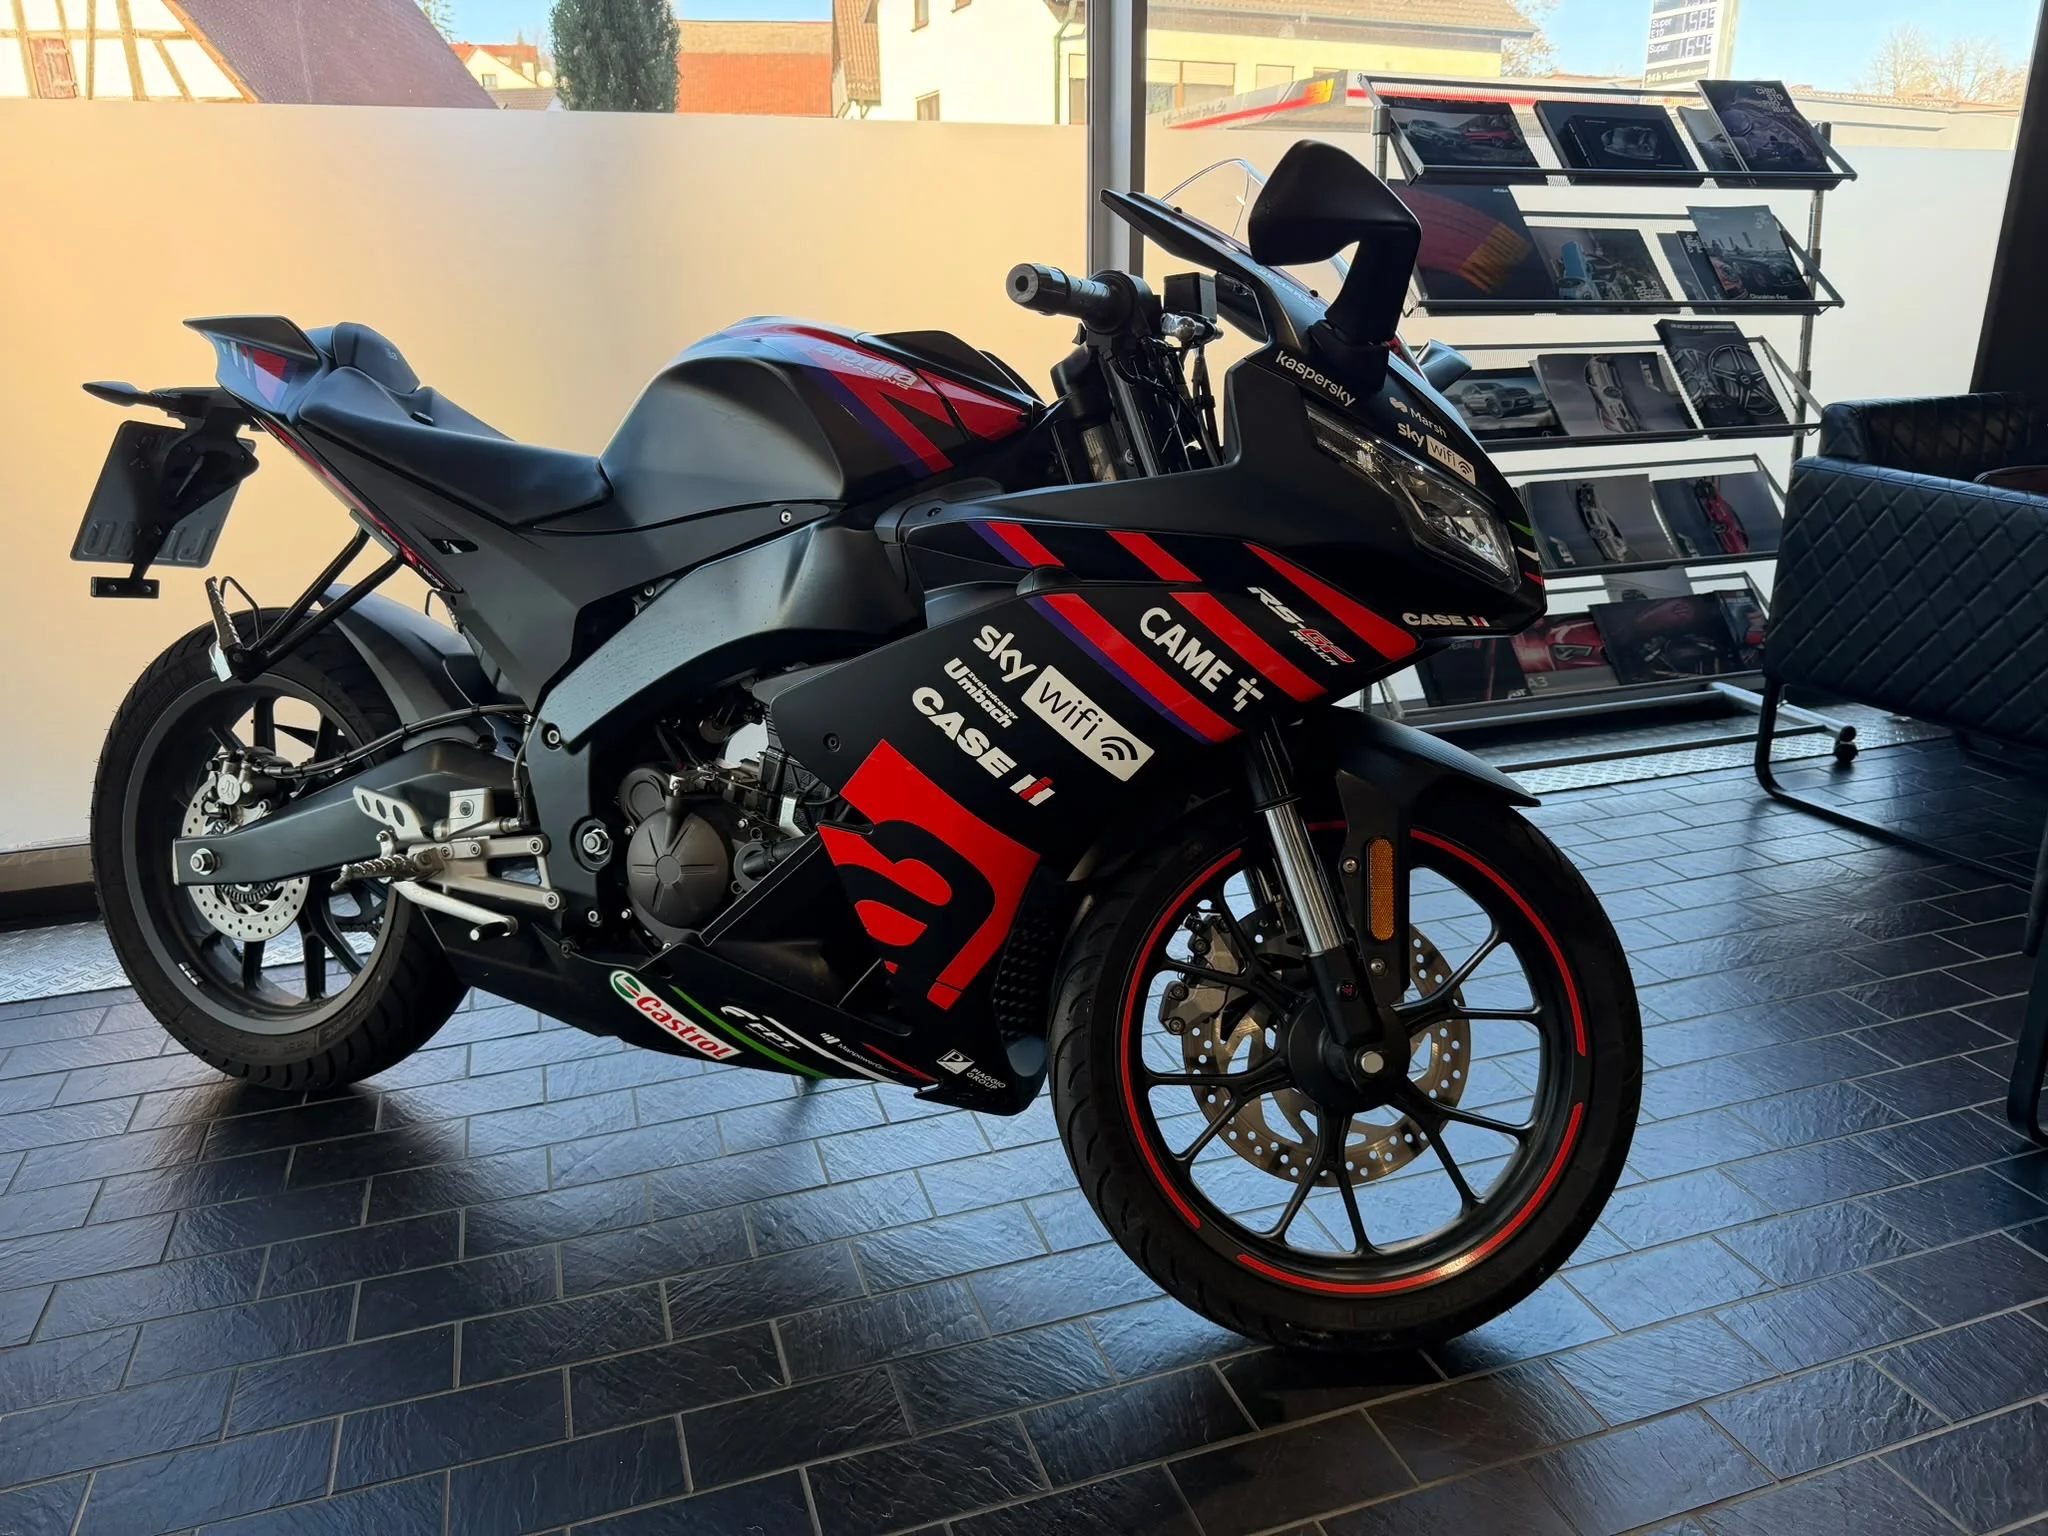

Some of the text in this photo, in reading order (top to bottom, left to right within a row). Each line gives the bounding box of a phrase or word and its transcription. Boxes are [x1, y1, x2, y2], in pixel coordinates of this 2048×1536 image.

[1650, 28, 1665, 39] E10
[1652, 18, 1673, 29] Super
[1648, 43, 1670, 54] Super
[1275, 350, 1356, 408] kaspersky
[1410, 408, 1448, 439] Marsh
[1397, 422, 1457, 467] sky wifi
[1402, 612, 1465, 627] CASE
[1140, 607, 1233, 693] CAME
[943, 657, 1013, 729] Umbach
[967, 671, 1019, 720] zweiradcenter
[972, 625, 1103, 741] sky wifi
[912, 686, 1017, 779] CASE
[636, 996, 733, 1058] Castrol
[748, 1022, 800, 1050] FPT
[966, 1072, 998, 1089] GROUP
[971, 1068, 1006, 1088] PIAGGIO
